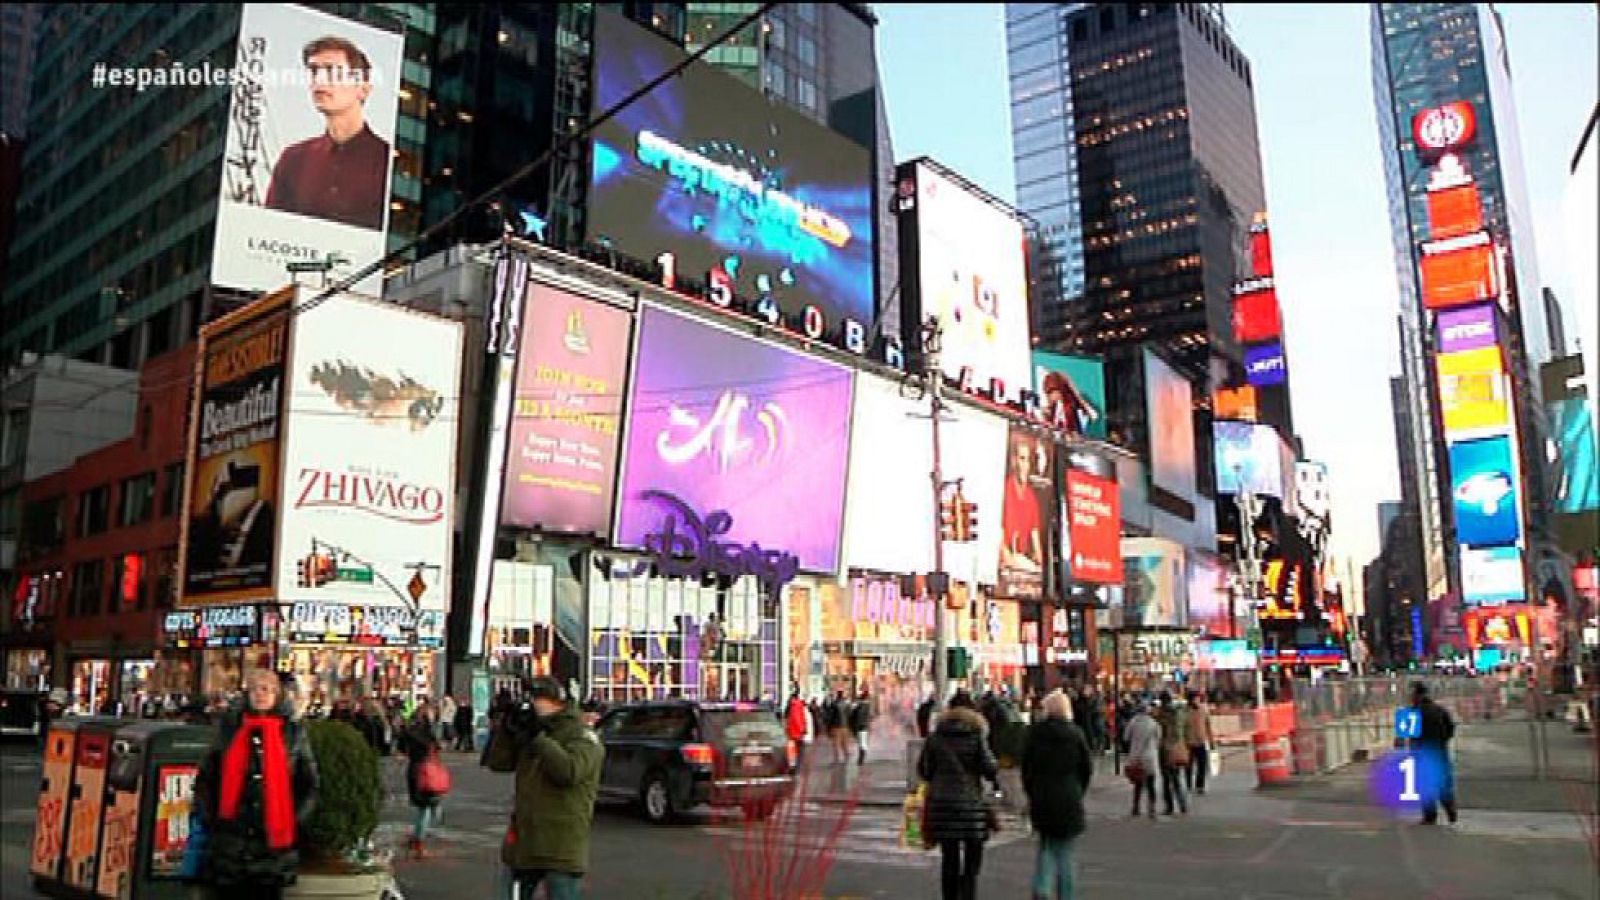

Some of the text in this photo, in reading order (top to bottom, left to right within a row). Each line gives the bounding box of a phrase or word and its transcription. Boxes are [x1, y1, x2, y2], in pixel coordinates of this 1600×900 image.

[247, 237, 319, 260] LACOSTE
[202, 376, 280, 437] Beautiful
[297, 468, 443, 514] ZHIVAGO
